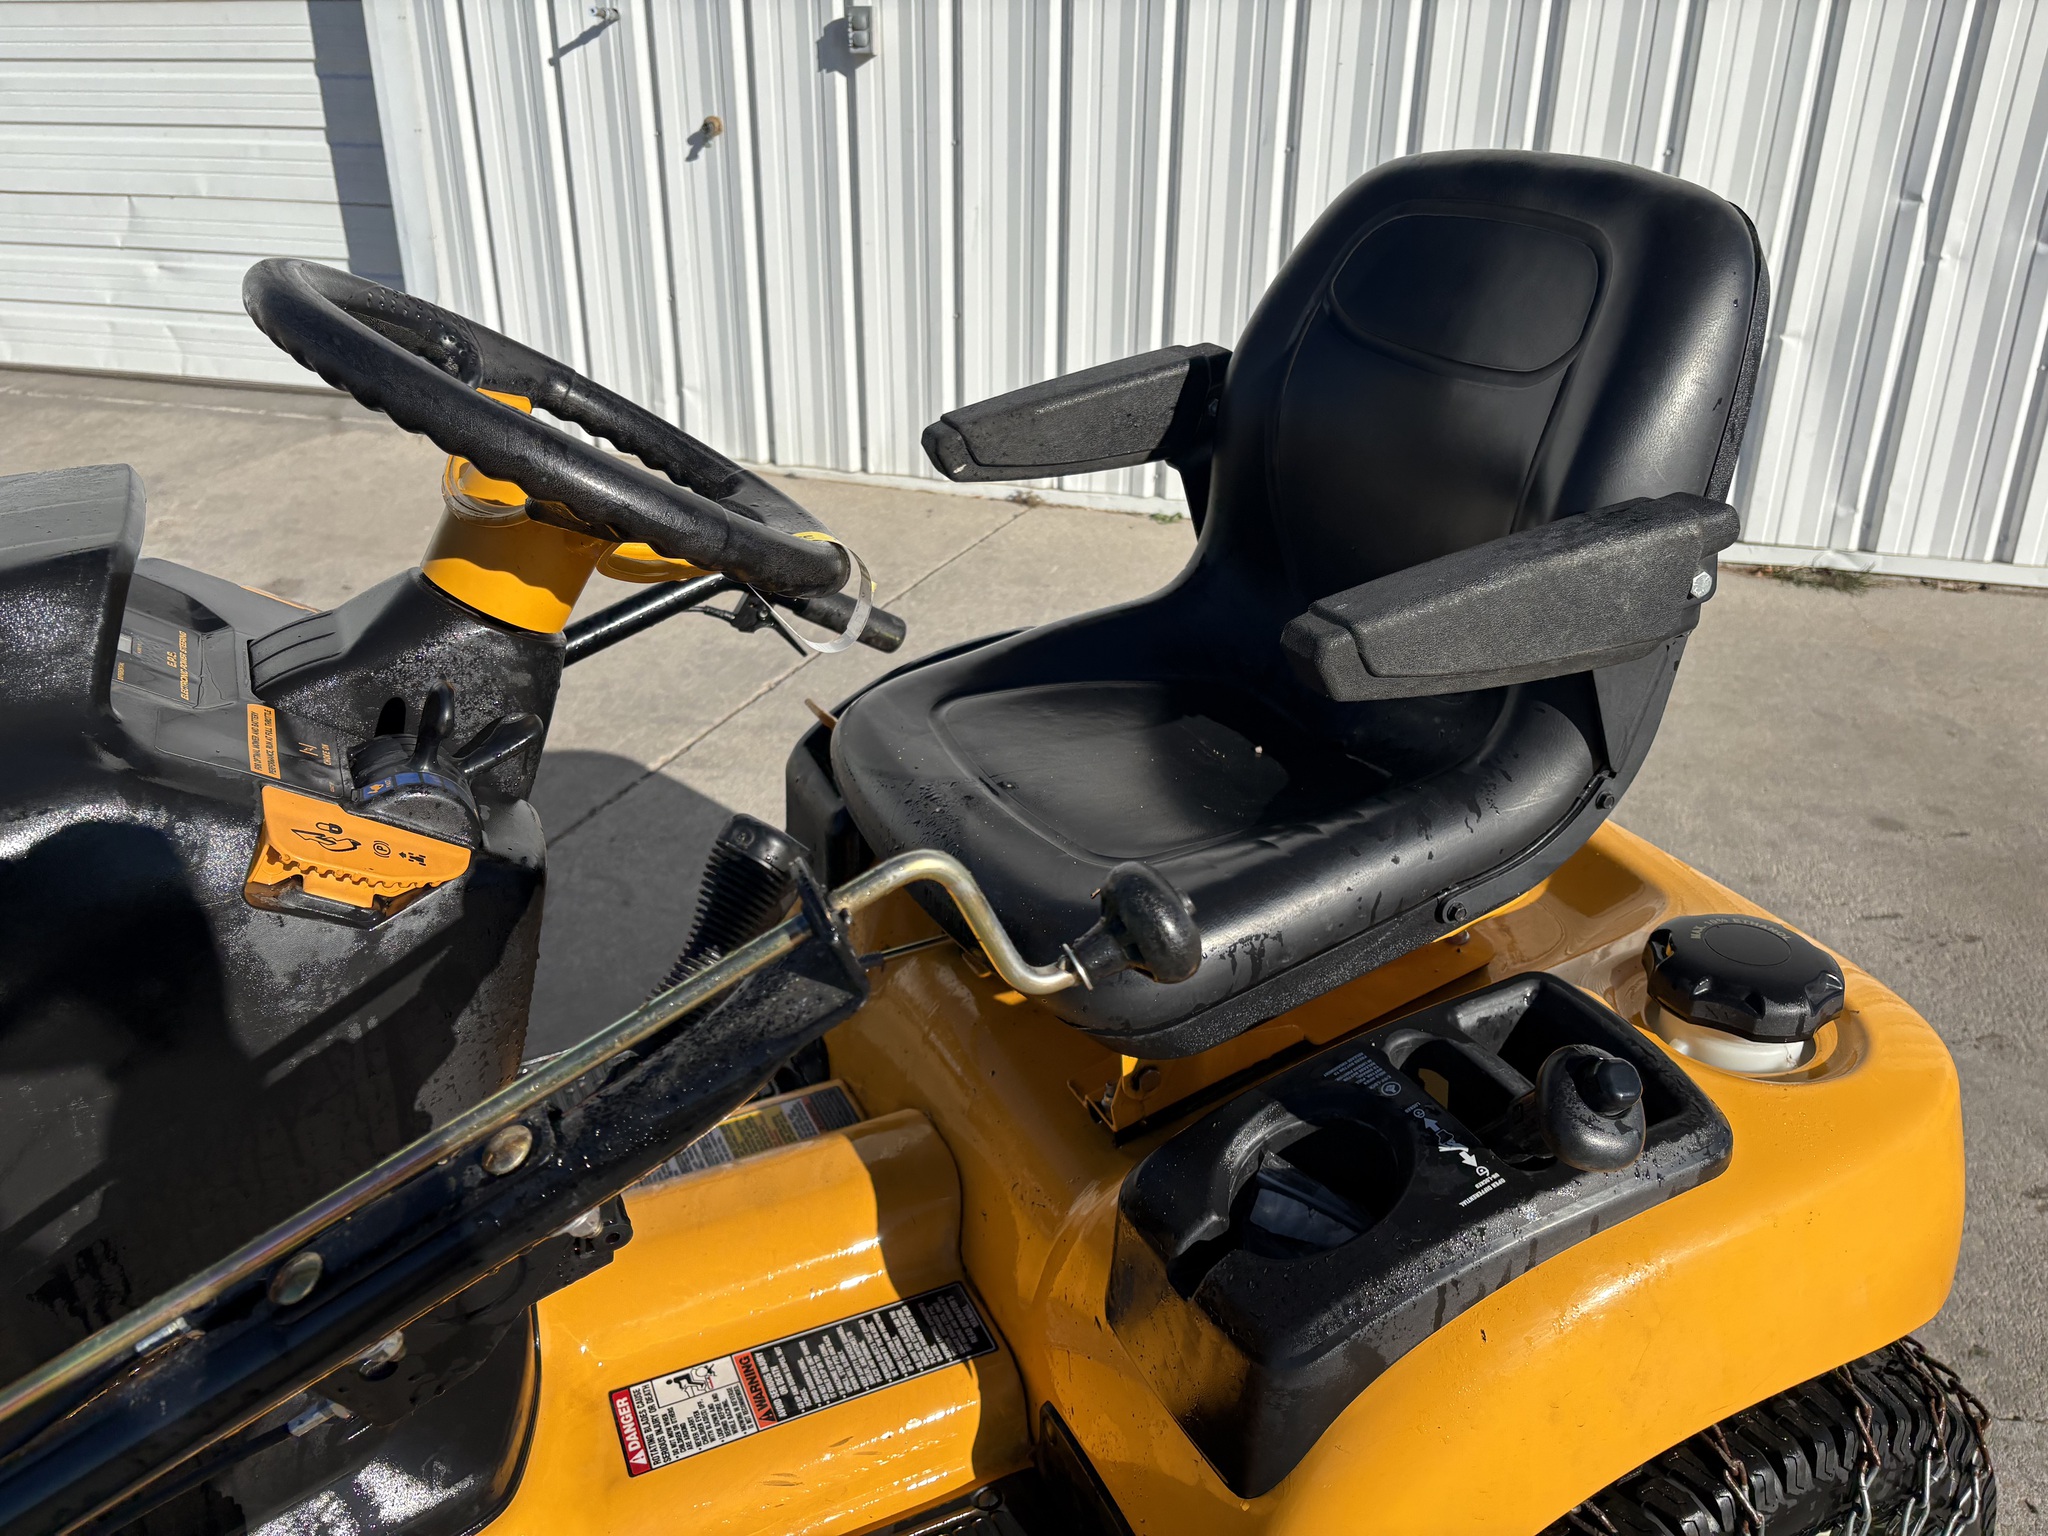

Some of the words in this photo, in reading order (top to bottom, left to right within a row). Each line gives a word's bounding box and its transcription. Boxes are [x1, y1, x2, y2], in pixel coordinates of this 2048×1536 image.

[178, 630, 187, 652] STEERING
[179, 651, 187, 669] POWER
[180, 668, 189, 700] ELECTRONIC
[250, 710, 258, 727] BATTERY
[251, 727, 259, 735] AND
[264, 726, 272, 736] FULL
[322, 749, 331, 765] CHOKE
[1704, 917, 1729, 927] 10%
[1732, 918, 1792, 941] ETHANOL
[1490, 1176, 1506, 1189] OPEN
[1458, 1184, 1493, 1208] DIFFERENTIAL
[888, 1309, 897, 1319] THE
[857, 1318, 869, 1333] COULD
[892, 1317, 902, 1327] AND
[821, 1334, 832, 1347] BACK
[881, 1331, 891, 1341] AND
[896, 1325, 910, 1343] BLADES
[874, 1337, 884, 1347] THE
[904, 1341, 914, 1351] THE
[773, 1345, 782, 1355] NOT
[827, 1345, 836, 1355] AND
[869, 1342, 883, 1362] OBJECTS
[754, 1351, 769, 1373] INJURY
[867, 1358, 876, 1368] AND
[901, 1355, 911, 1365] ALL
[769, 1364, 784, 1385] DEATH
[835, 1363, 846, 1376] STOP
[871, 1367, 883, 1382] PLACE
[738, 1354, 768, 1411] WARNING
[763, 1372, 780, 1399] SERIOUS
[784, 1372, 795, 1386] DOWN
[822, 1377, 834, 1393] COULD
[641, 1383, 654, 1404] DEATH
[777, 1384, 789, 1395] OR
[789, 1385, 799, 1395] AND
[810, 1389, 821, 1403] AVOID
[817, 1383, 827, 1394] NOT
[632, 1387, 645, 1409] CAUSE
[711, 1392, 719, 1402] AND
[726, 1386, 737, 1407] REVERSE
[647, 1403, 656, 1413] OR
[707, 1402, 715, 1412] AND
[714, 1402, 725, 1420] BEFORE
[773, 1397, 787, 1418] AVOID
[638, 1408, 652, 1433] BLADES
[661, 1413, 670, 1426] WHEN
[667, 1406, 677, 1424] OTHERS
[692, 1409, 701, 1422] EVEN
[711, 1412, 720, 1427] DOWN
[735, 1411, 746, 1431] MOWING
[743, 1415, 752, 1424] NOT
[615, 1396, 641, 1452] DANGER
[650, 1412, 663, 1436] INJURY
[672, 1423, 679, 1431] OR
[679, 1421, 690, 1440] AROUND
[687, 1415, 697, 1432] CARRY
[721, 1419, 731, 1437] BEHIND
[728, 1419, 738, 1434] WHILE
[665, 1426, 674, 1438] MOW
[692, 1431, 702, 1447] NEVER
[697, 1422, 709, 1445] CHILDREN
[706, 1429, 716, 1442] WITH
[715, 1426, 724, 1439] LOOK
[645, 1433, 661, 1465] ROTATING
[657, 1434, 671, 1463] SERIOUS
[669, 1438, 677, 1448] NOT
[674, 1430, 686, 1453] CHILDREN
[685, 1440, 693, 1450] ARE
